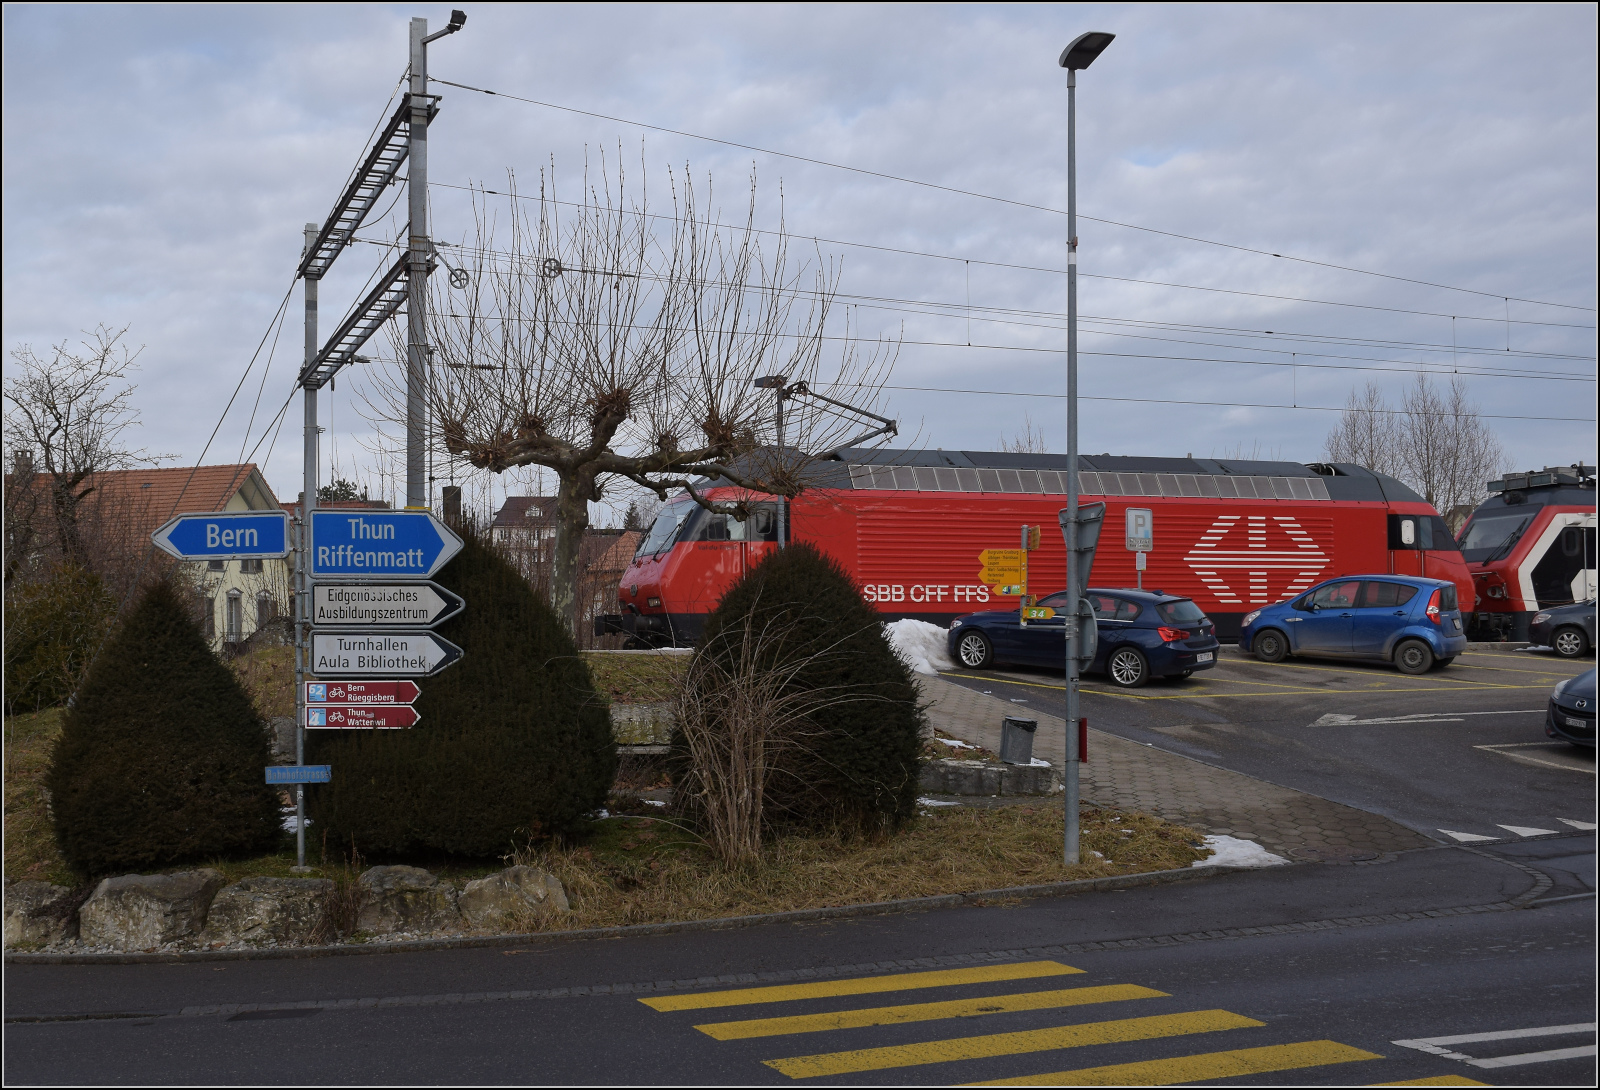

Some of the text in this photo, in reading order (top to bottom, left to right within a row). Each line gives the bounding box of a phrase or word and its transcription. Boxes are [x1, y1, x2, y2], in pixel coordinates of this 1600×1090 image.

[347, 517, 395, 539] Thun
[1134, 514, 1145, 535] P
[206, 523, 258, 548] Bern
[318, 544, 424, 567] Riffenmatt
[863, 584, 990, 603] SBB CFF FFS
[318, 606, 428, 622] Ausbildungszentrum
[336, 637, 408, 651] Turnhallen
[318, 655, 426, 668] Aula Bibliothek
[309, 684, 324, 695] 62
[347, 684, 365, 692] Bern
[347, 693, 395, 703] Rüeggisberg
[308, 712, 320, 726] 4
[347, 708, 366, 716] Thun
[347, 718, 386, 726] Wattenwil
[267, 769, 329, 781] Bahnhofstrasse
